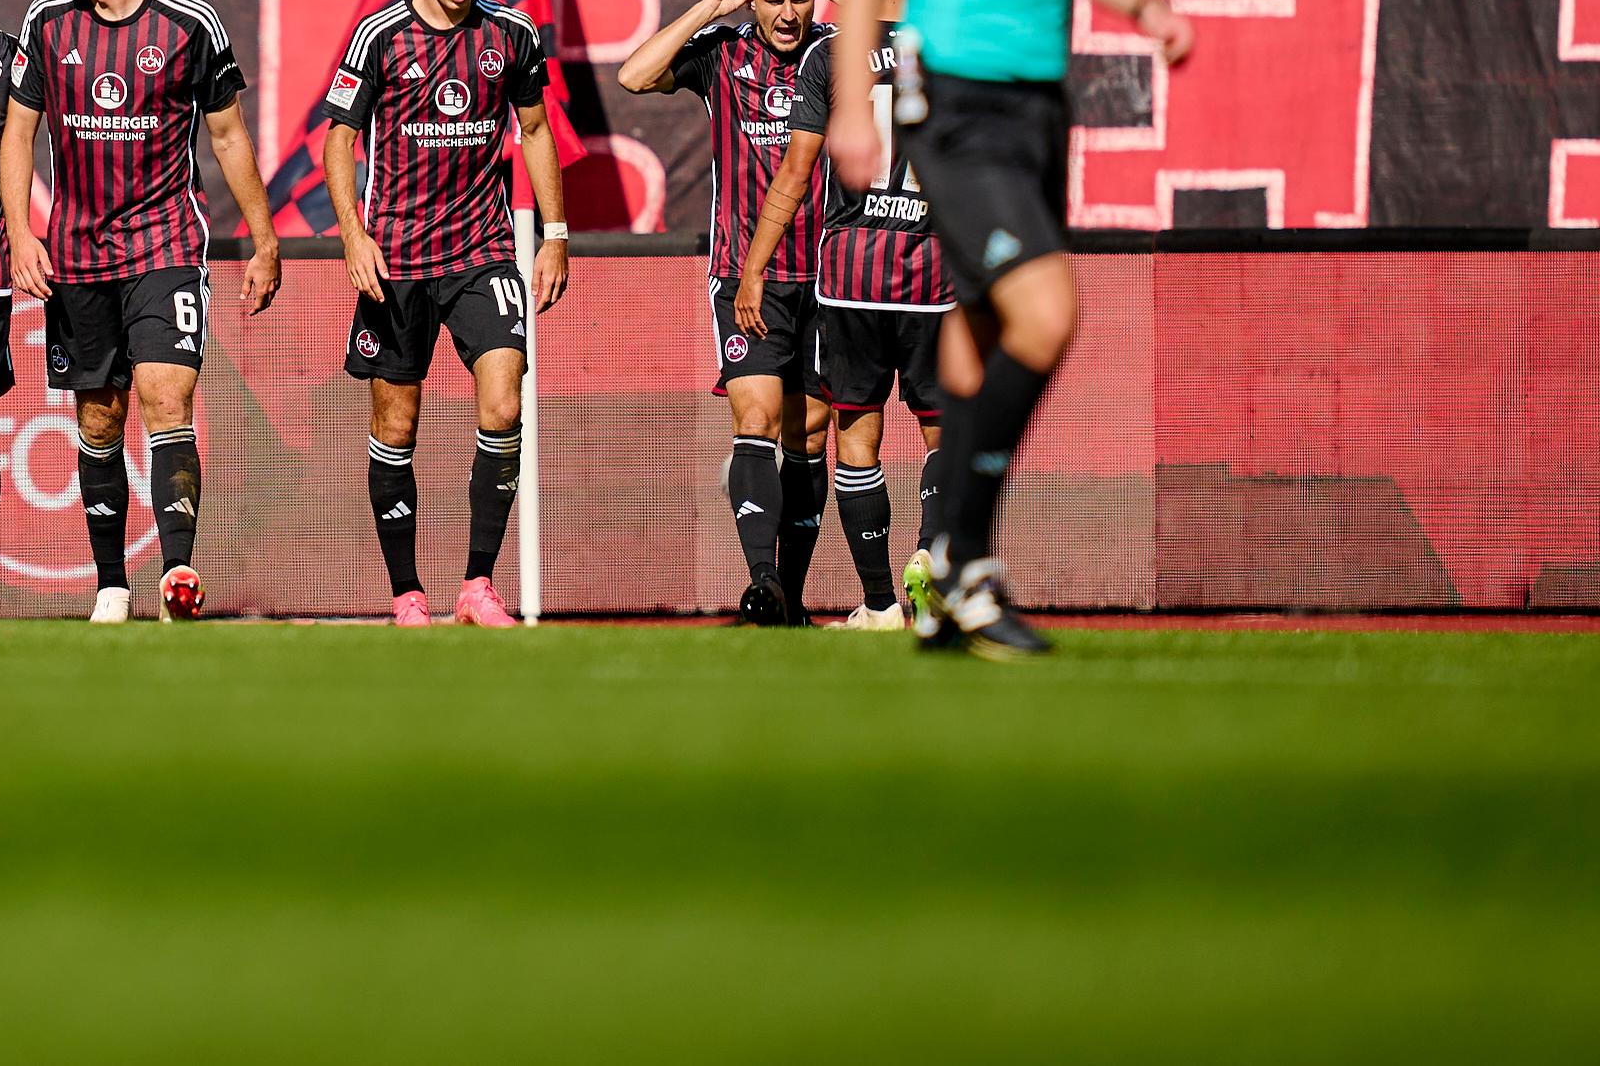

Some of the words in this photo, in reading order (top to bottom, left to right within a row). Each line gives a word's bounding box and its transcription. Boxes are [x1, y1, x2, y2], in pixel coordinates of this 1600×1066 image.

[62, 113, 159, 130] NÜRNBERGER
[401, 119, 496, 137] NÜRNBERGER
[75, 129, 146, 142] VERSICHERUNG
[416, 136, 487, 148] VERSICHERUNG
[489, 276, 525, 317] 14
[173, 291, 198, 333] 6
